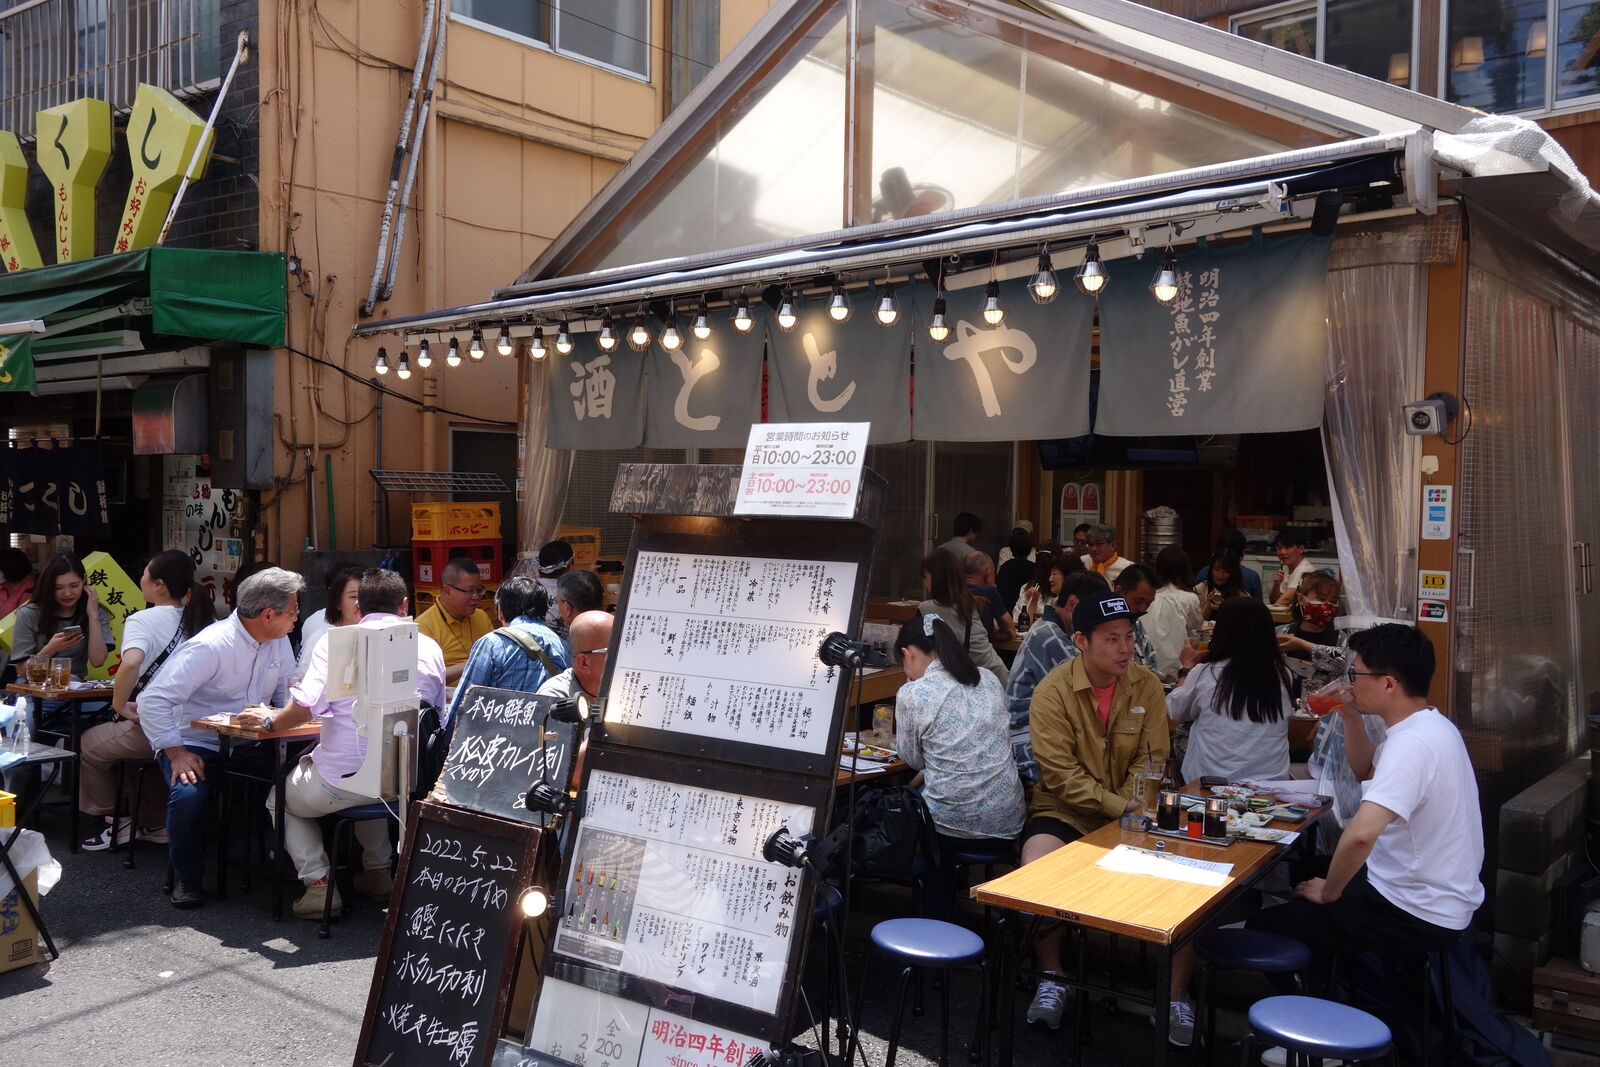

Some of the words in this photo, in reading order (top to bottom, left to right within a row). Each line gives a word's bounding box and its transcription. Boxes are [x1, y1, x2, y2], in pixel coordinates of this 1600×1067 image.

[54, 114, 70, 170] く
[141, 107, 162, 170] し
[58, 182, 70, 261] もんじゃ
[1194, 267, 1221, 393] 明治四年創業
[569, 355, 616, 421] 酒
[752, 445, 763, 464] 平日
[765, 431, 850, 442] 営業時間のお知らせ
[186, 503, 205, 518] の味
[449, 523, 489, 535] ホッピー
[675, 576, 687, 593] 一品
[663, 632, 677, 656] 鮮魚
[466, 696, 538, 728] 本日の鮮魚
[635, 682, 650, 720] デザート
[447, 764, 495, 788] マツカワ
[665, 790, 681, 829] ハイボール
[726, 795, 745, 846] 東京名物
[412, 866, 509, 911] 本日のおすすめ
[761, 879, 778, 914] 酎ハイ
[772, 870, 799, 938] お飲み物
[675, 920, 694, 978] ソフトドリンク
[695, 941, 710, 976] ワイン
[747, 950, 764, 988] 果実酒
